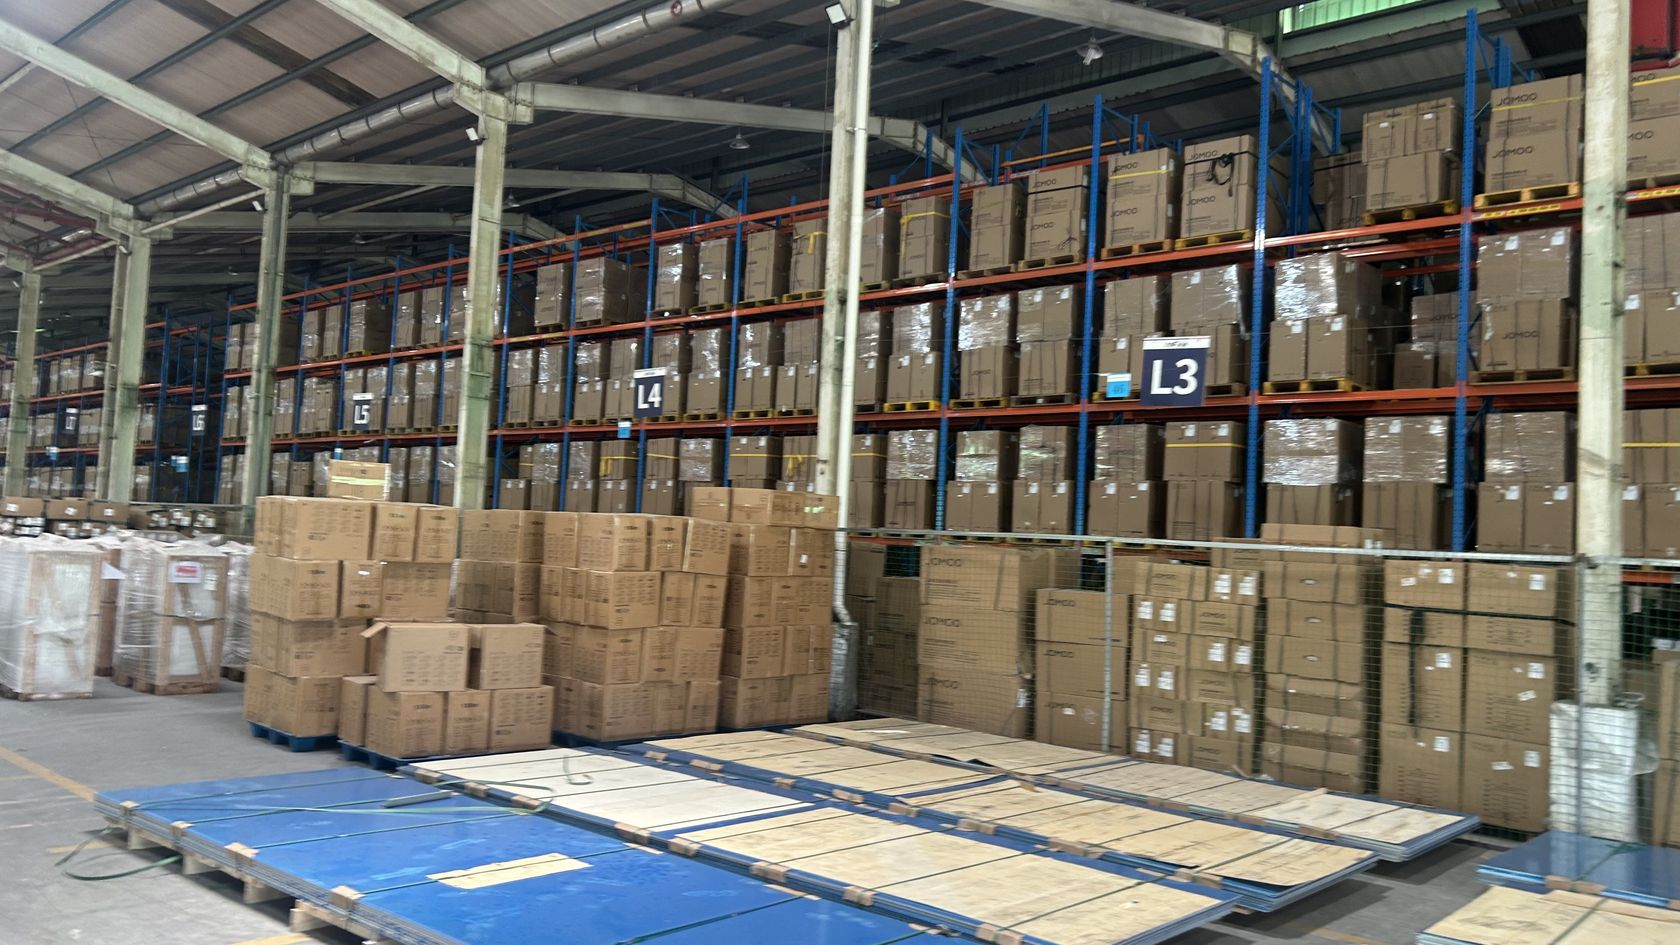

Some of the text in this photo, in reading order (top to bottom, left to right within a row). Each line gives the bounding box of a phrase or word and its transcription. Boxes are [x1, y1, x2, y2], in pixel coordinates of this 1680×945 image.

[1497, 93, 1538, 107] JOMOO
[1188, 150, 1218, 161] JOMOO
[1492, 146, 1533, 158] JOMOO
[1187, 195, 1216, 206] JOMOO
[1111, 207, 1137, 217] JOMOO
[1150, 358, 1199, 395] L3
[637, 383, 662, 409] L4
[354, 405, 370, 424] L5
[193, 415, 206, 431] L6
